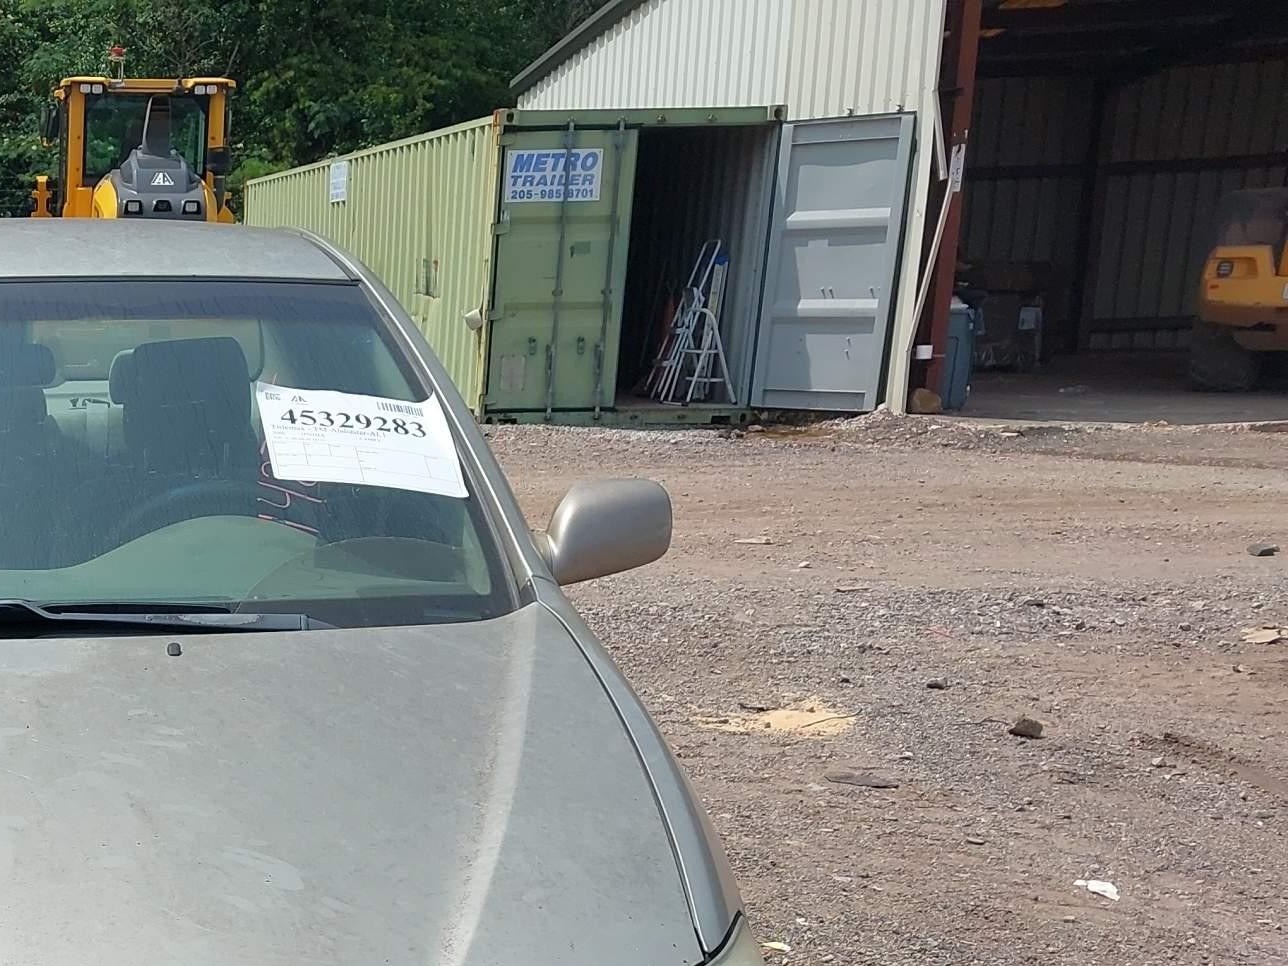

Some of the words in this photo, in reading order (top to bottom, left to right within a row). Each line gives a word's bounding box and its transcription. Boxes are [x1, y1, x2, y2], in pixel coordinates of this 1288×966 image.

[511, 151, 599, 173] METRO
[510, 173, 595, 187] TRAILER
[280, 408, 427, 439] 45329283
